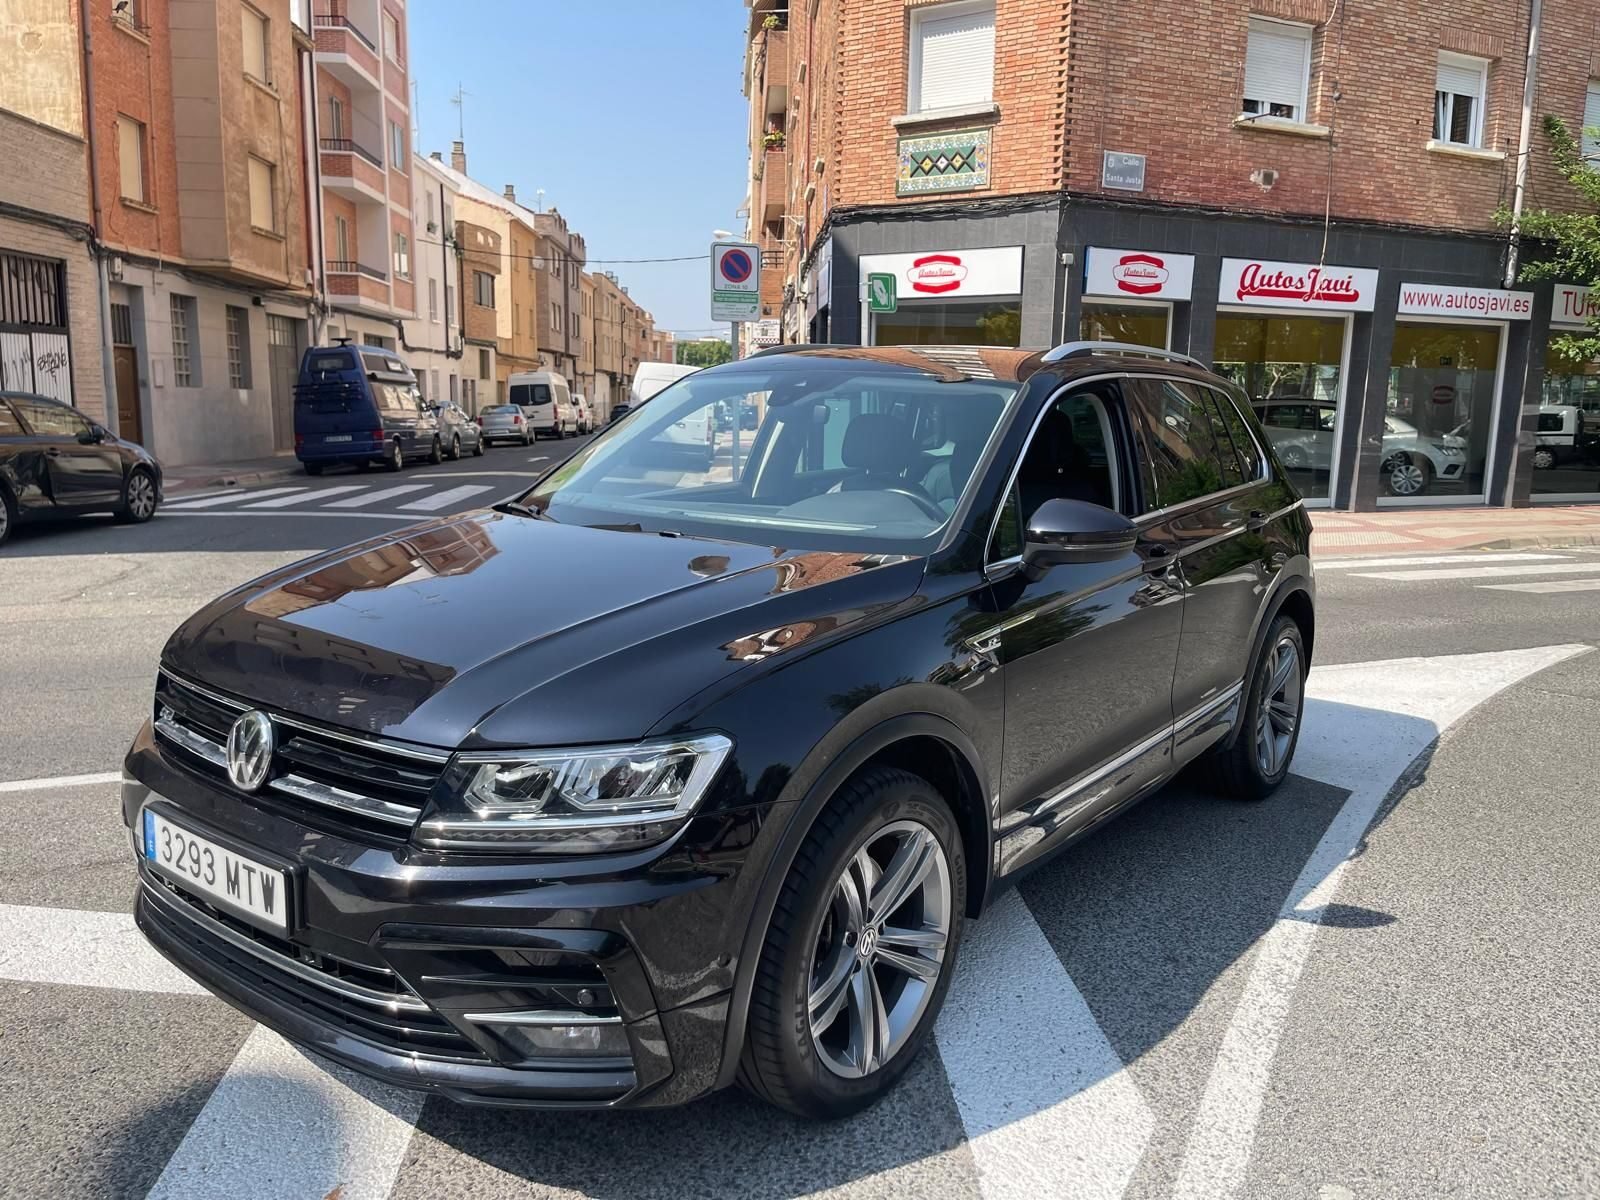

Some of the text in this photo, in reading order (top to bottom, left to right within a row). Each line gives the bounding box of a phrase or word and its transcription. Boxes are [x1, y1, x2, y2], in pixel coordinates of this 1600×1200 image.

[1122, 156, 1140, 167] Calle
[1106, 173, 1142, 185] Santa Justa
[1403, 291, 1529, 315] www.autosjavi.es
[162, 826, 275, 915] 3293 MTW
